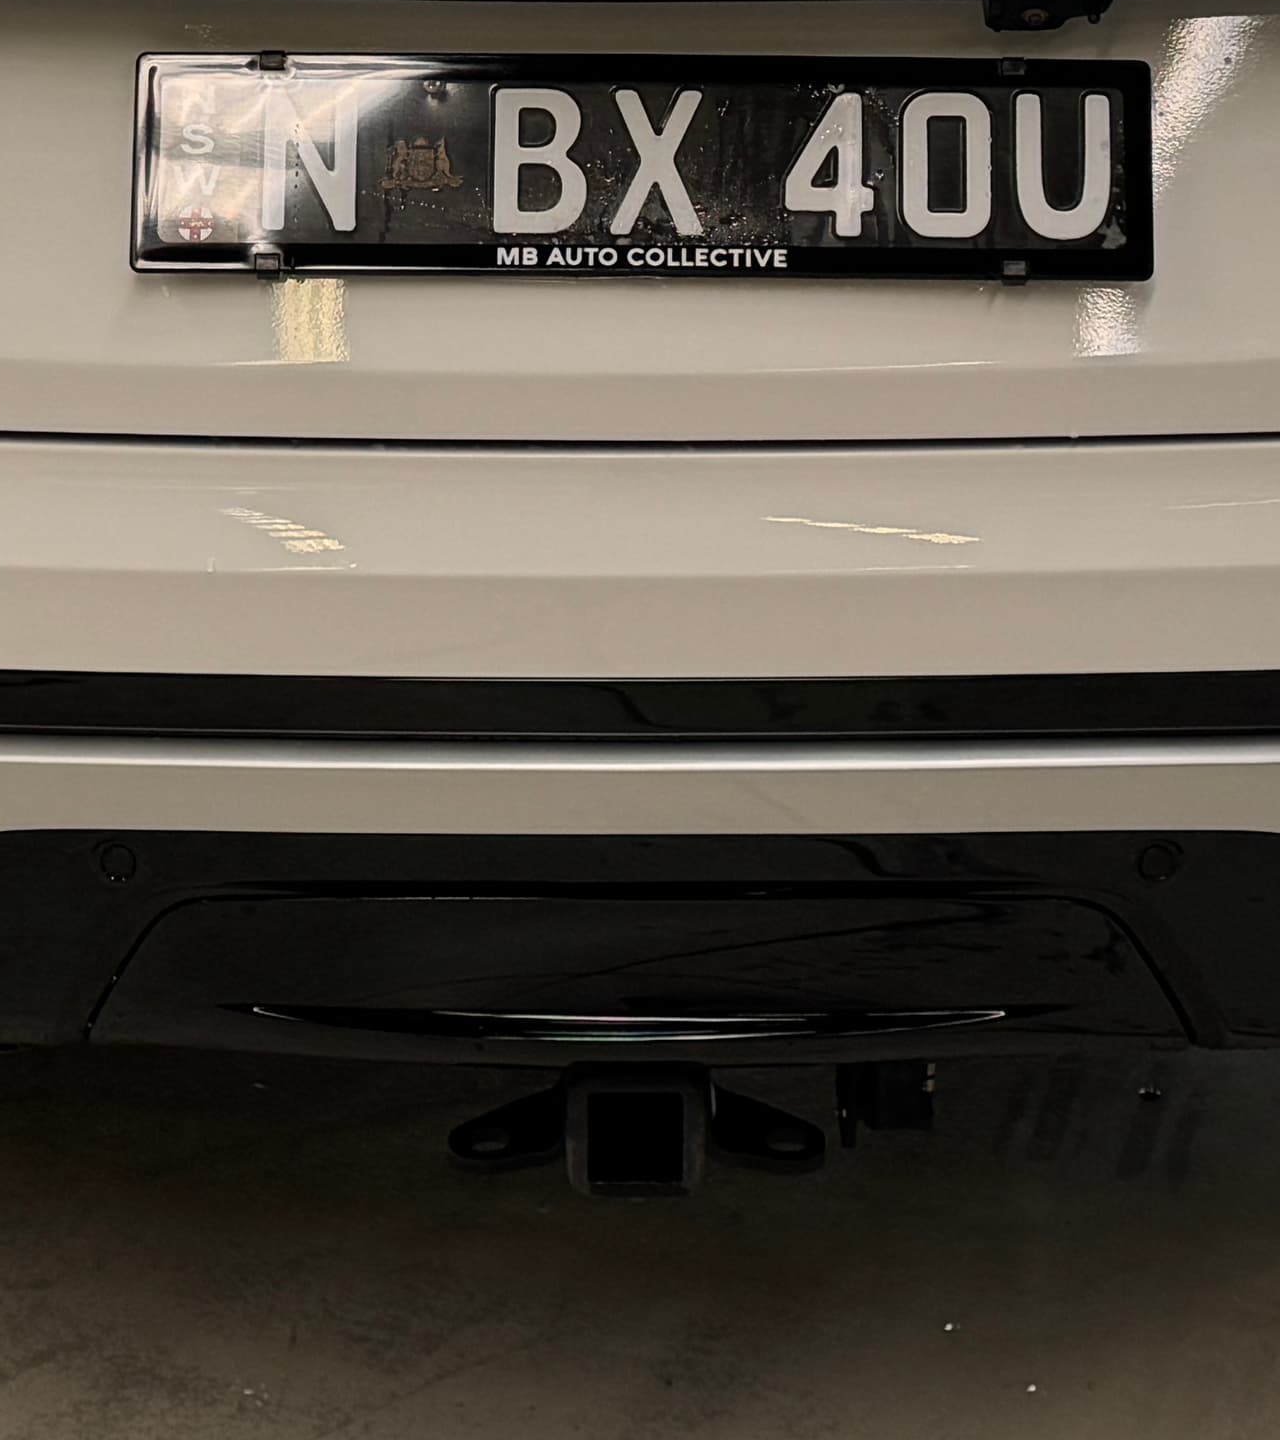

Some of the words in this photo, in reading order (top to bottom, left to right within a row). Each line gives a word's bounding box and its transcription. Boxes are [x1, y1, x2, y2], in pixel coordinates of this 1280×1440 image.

[492, 88, 704, 236] BX
[496, 247, 538, 266] MB
[546, 247, 618, 267] AUTO
[627, 247, 788, 268] COLLECTIVE
